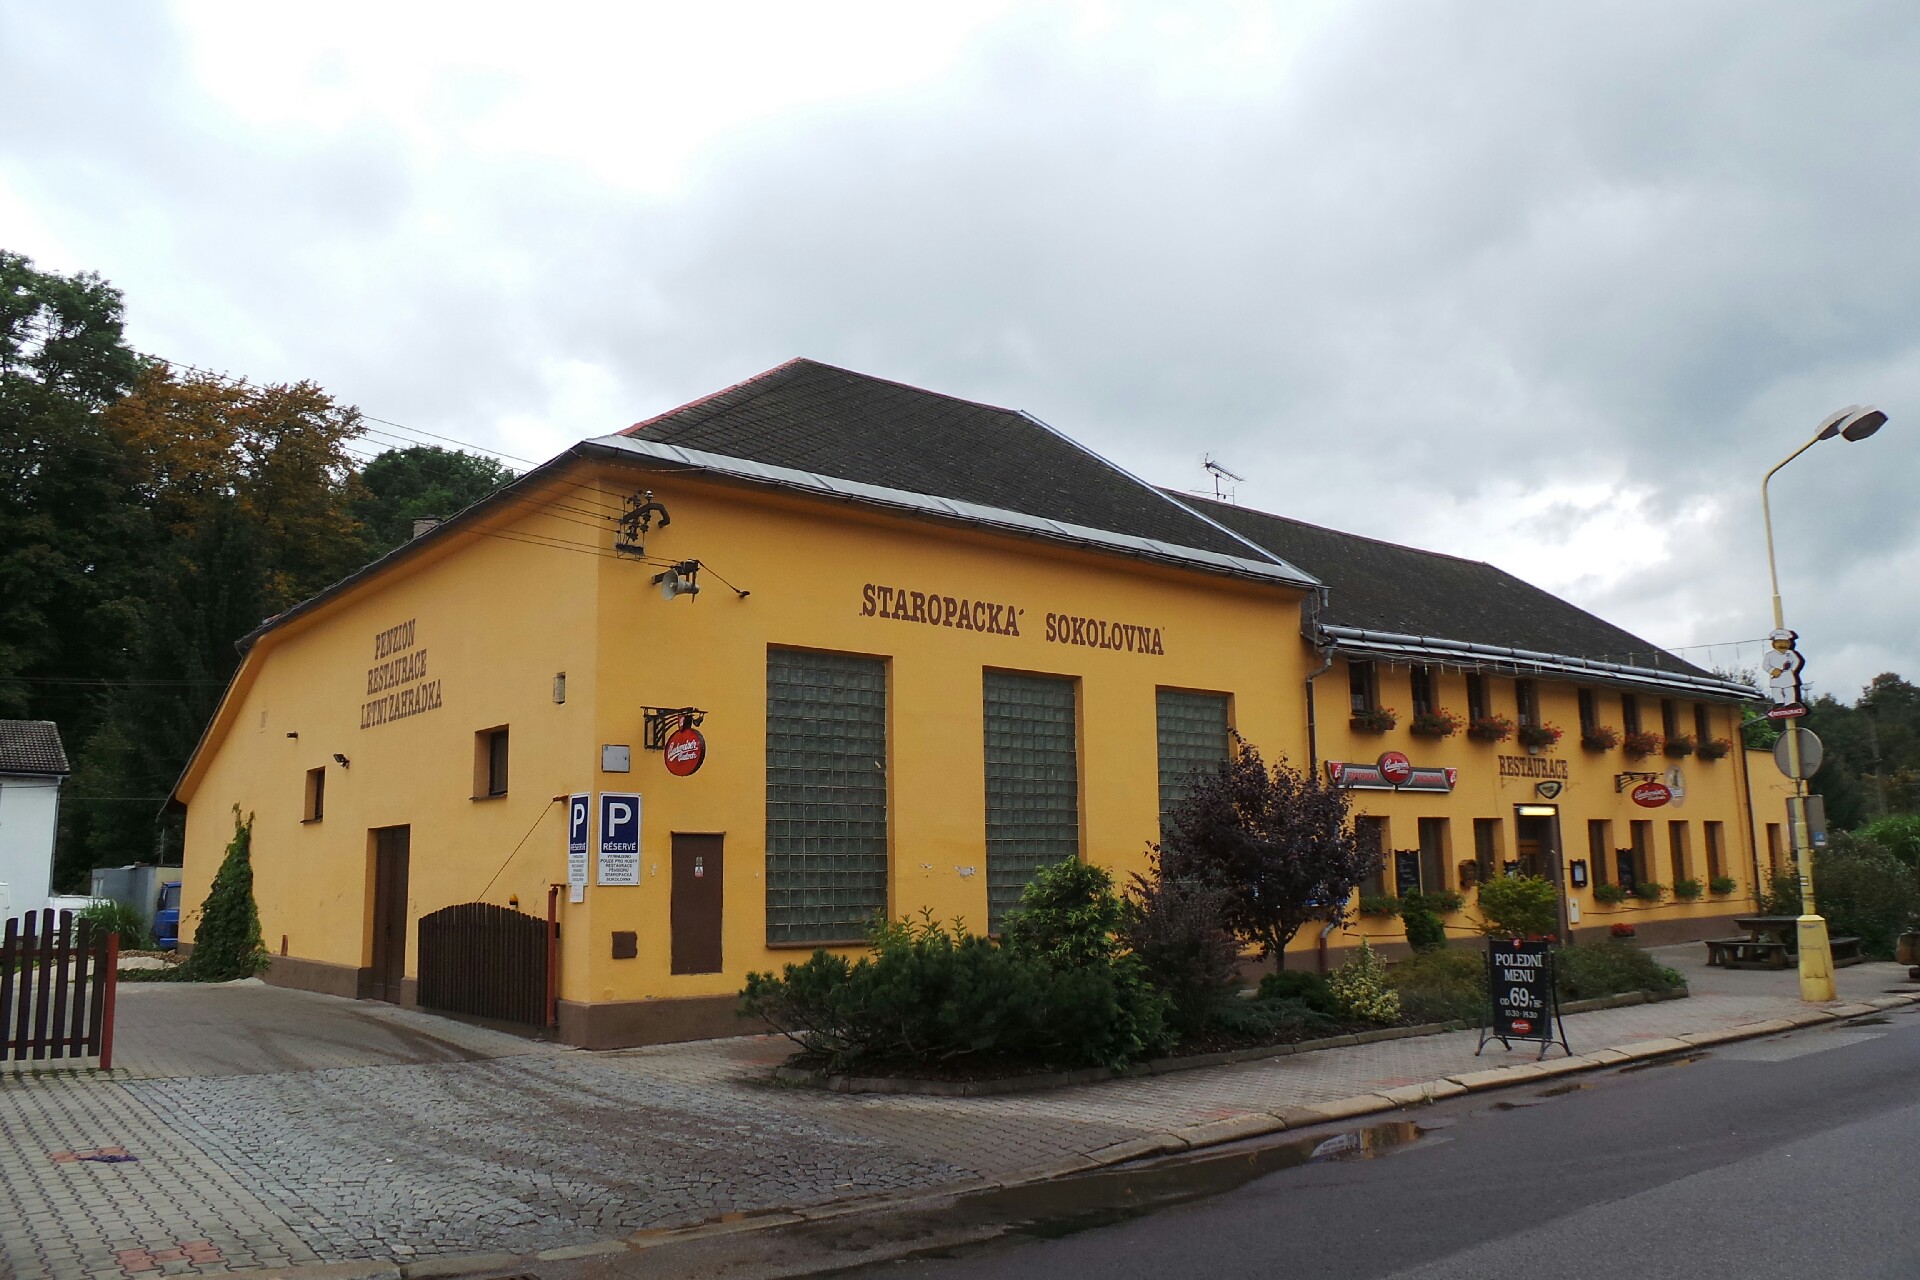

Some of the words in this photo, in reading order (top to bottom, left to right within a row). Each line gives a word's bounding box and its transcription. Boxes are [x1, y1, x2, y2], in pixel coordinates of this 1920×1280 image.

[374, 618, 416, 660] PENZION
[367, 648, 427, 696] RESTAURACE
[388, 678, 443, 722] ZAHRÁDKA
[1498, 755, 1568, 779] RESTAURACE
[573, 803, 585, 838] P
[609, 802, 632, 837] P
[603, 841, 636, 851] RÉSERVÉ
[1495, 952, 1543, 968] POLEDNÍ
[1504, 969, 1535, 983] MENU
[1499, 997, 1510, 1006] OD
